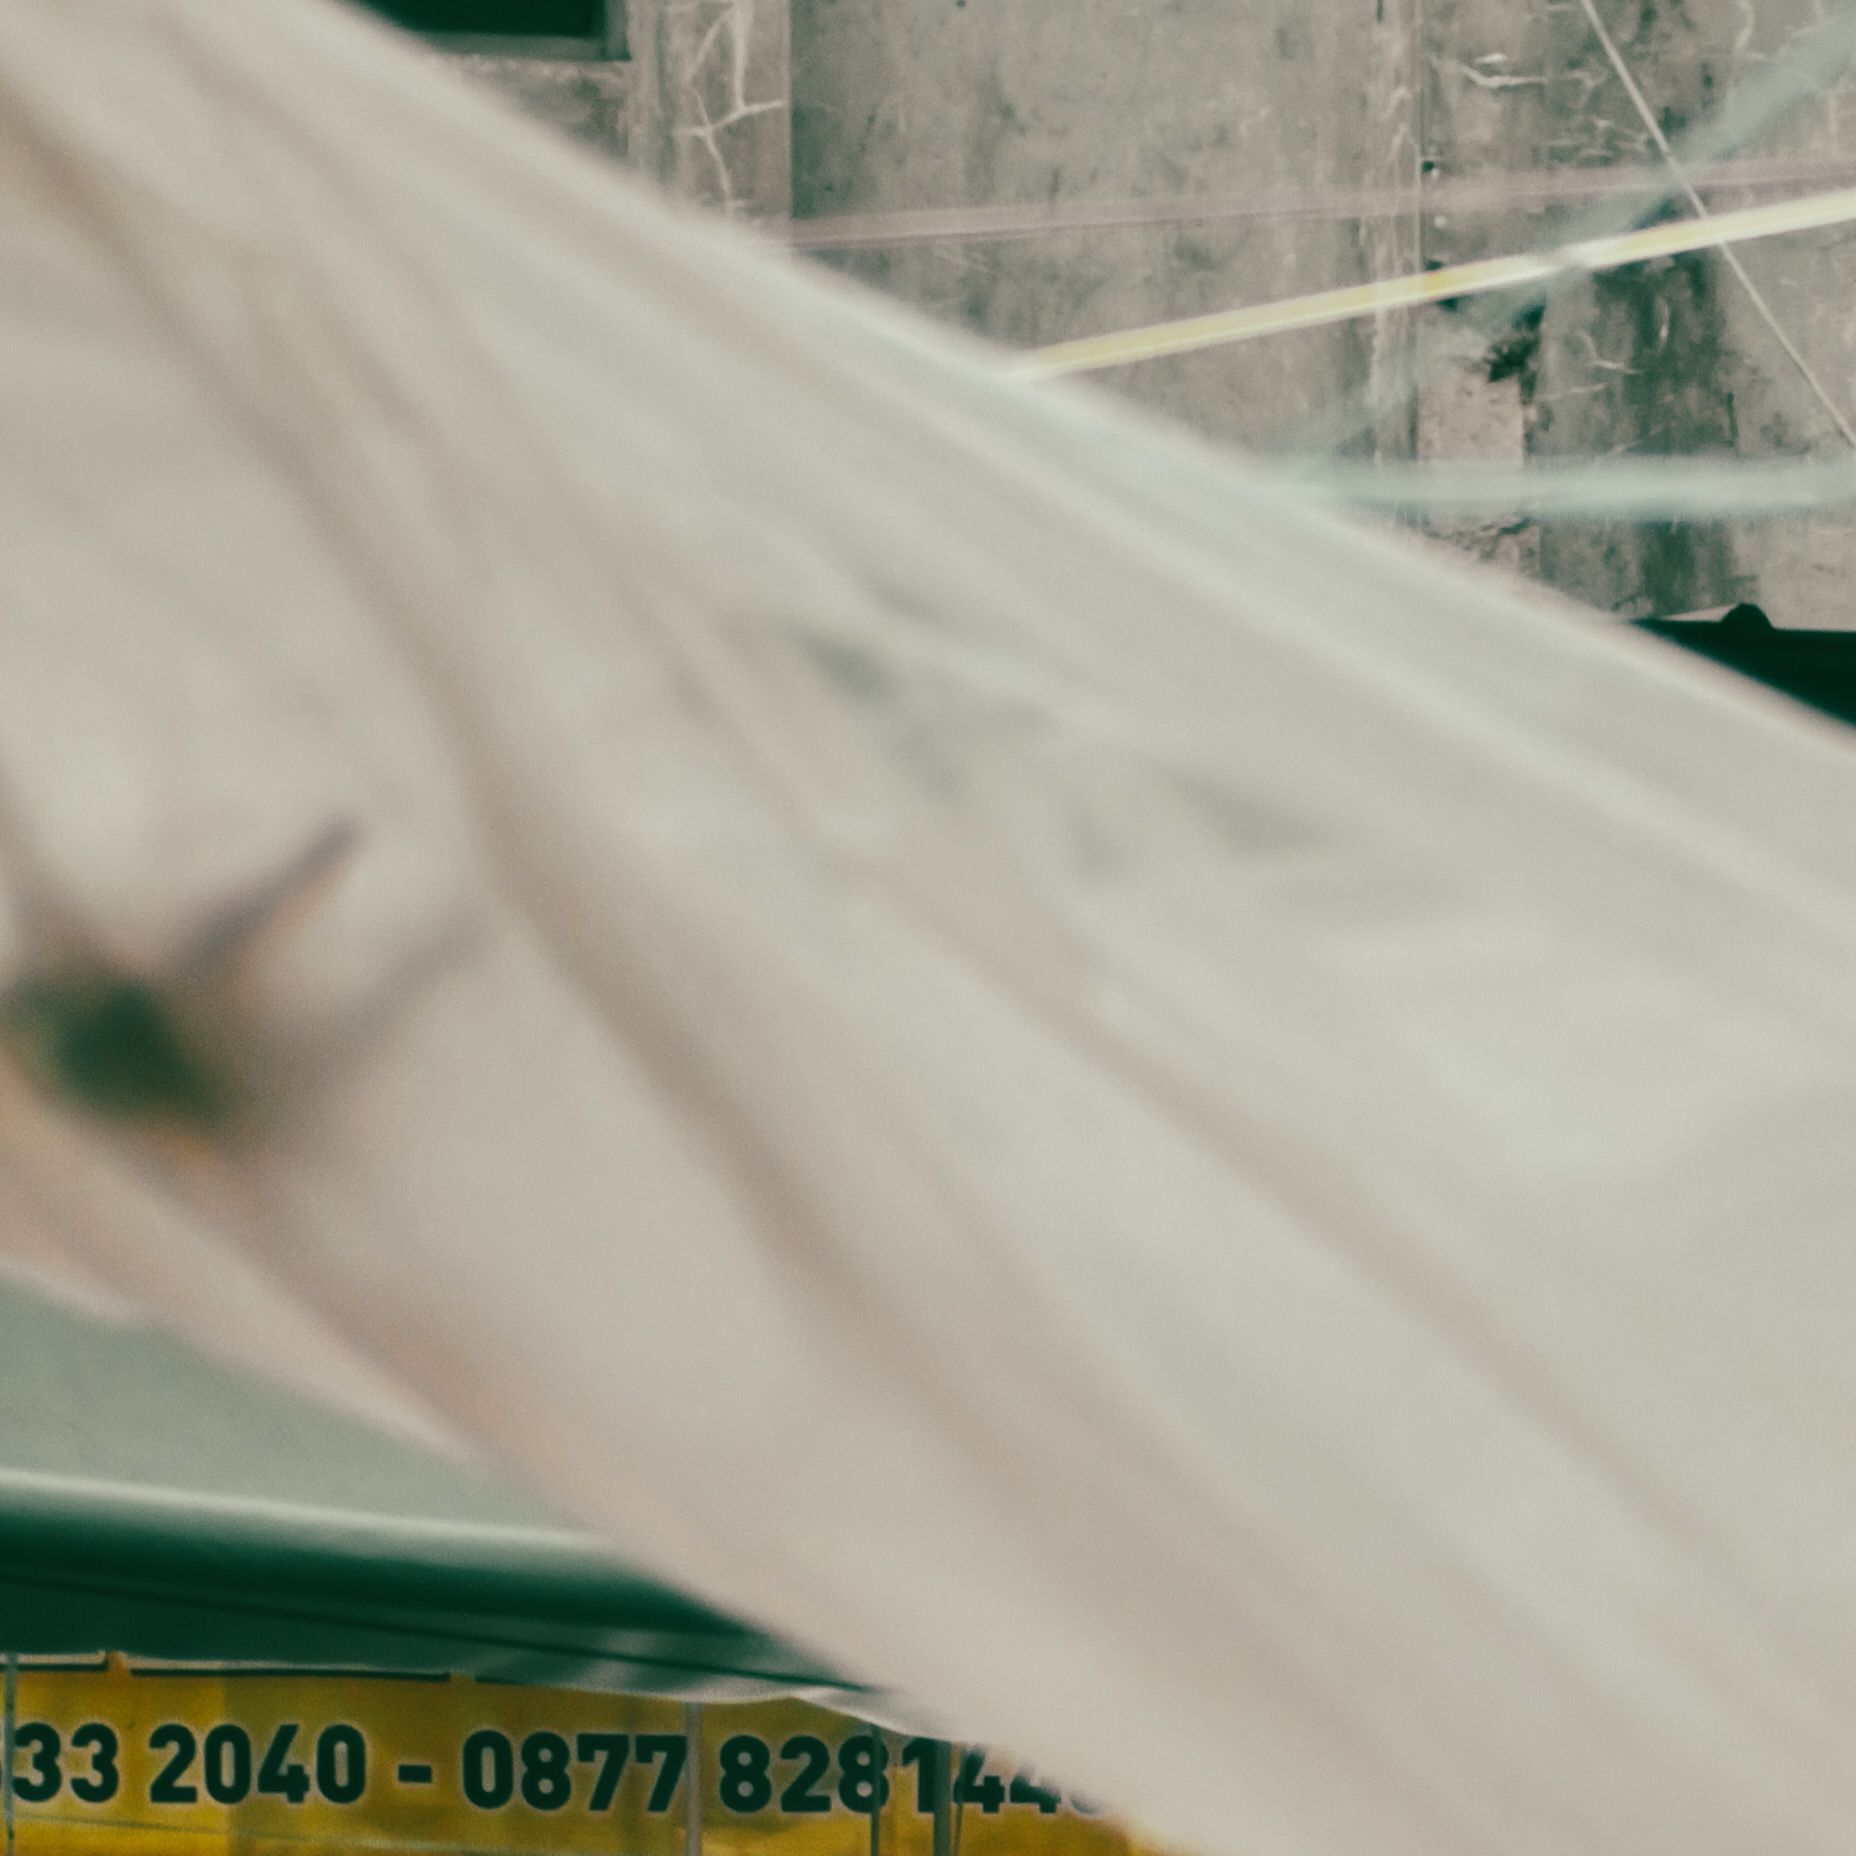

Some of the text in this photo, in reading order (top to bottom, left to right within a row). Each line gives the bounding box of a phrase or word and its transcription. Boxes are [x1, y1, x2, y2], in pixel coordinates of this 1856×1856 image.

[12, 1721, 1104, 1816] 33 2040 - 0877 828144
